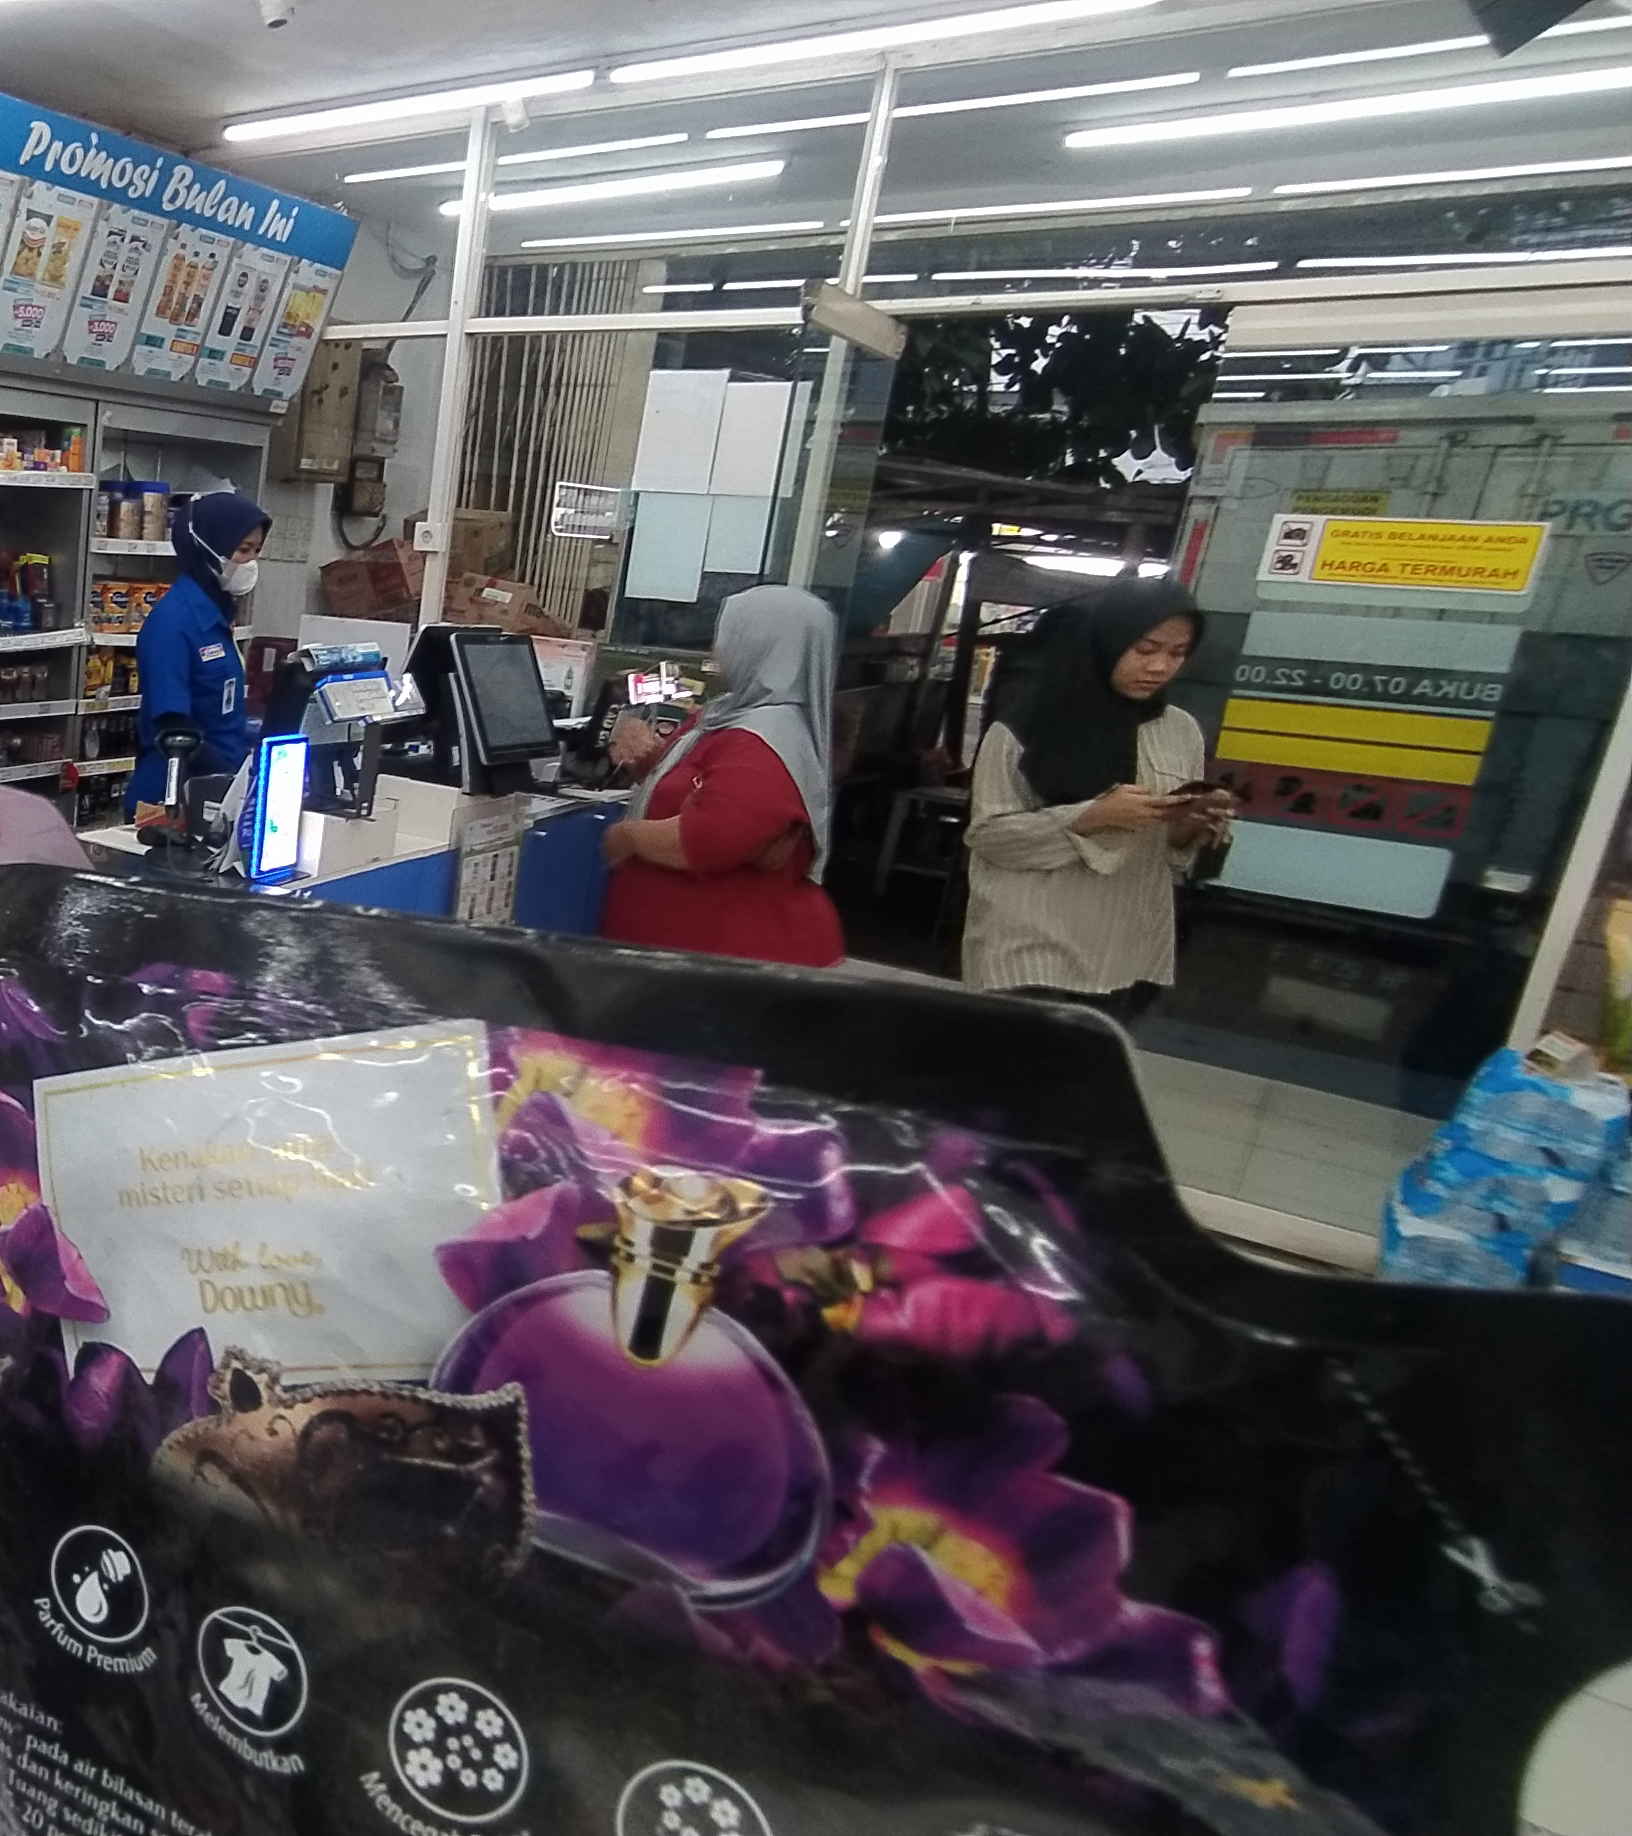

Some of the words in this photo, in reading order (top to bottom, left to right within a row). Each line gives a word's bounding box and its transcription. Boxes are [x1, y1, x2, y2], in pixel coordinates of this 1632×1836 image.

[19, 120, 163, 199] Promosi
[161, 161, 256, 232] Bulan
[257, 203, 301, 244] Ini
[1329, 527, 1384, 542] GRATIS
[1386, 530, 1481, 545] BELANJAAN
[1483, 533, 1530, 546] ANDA
[1320, 558, 1390, 576] HARGA
[1397, 561, 1521, 582] TERMURAH
[117, 1176, 206, 1210] misteri
[180, 1243, 249, 1276] With
[33, 1596, 84, 1659] Parfum
[85, 1644, 159, 1674] Premium
[189, 1692, 307, 1774] Melembutkan
[8, 1768, 60, 1818] Tuang
[16, 1752, 50, 1783] dan
[53, 1771, 146, 1836] keringkan
[24, 1733, 70, 1767] pada
[73, 1757, 98, 1780] air
[100, 1768, 167, 1820] bilasan
[21, 1803, 45, 1830] 20
